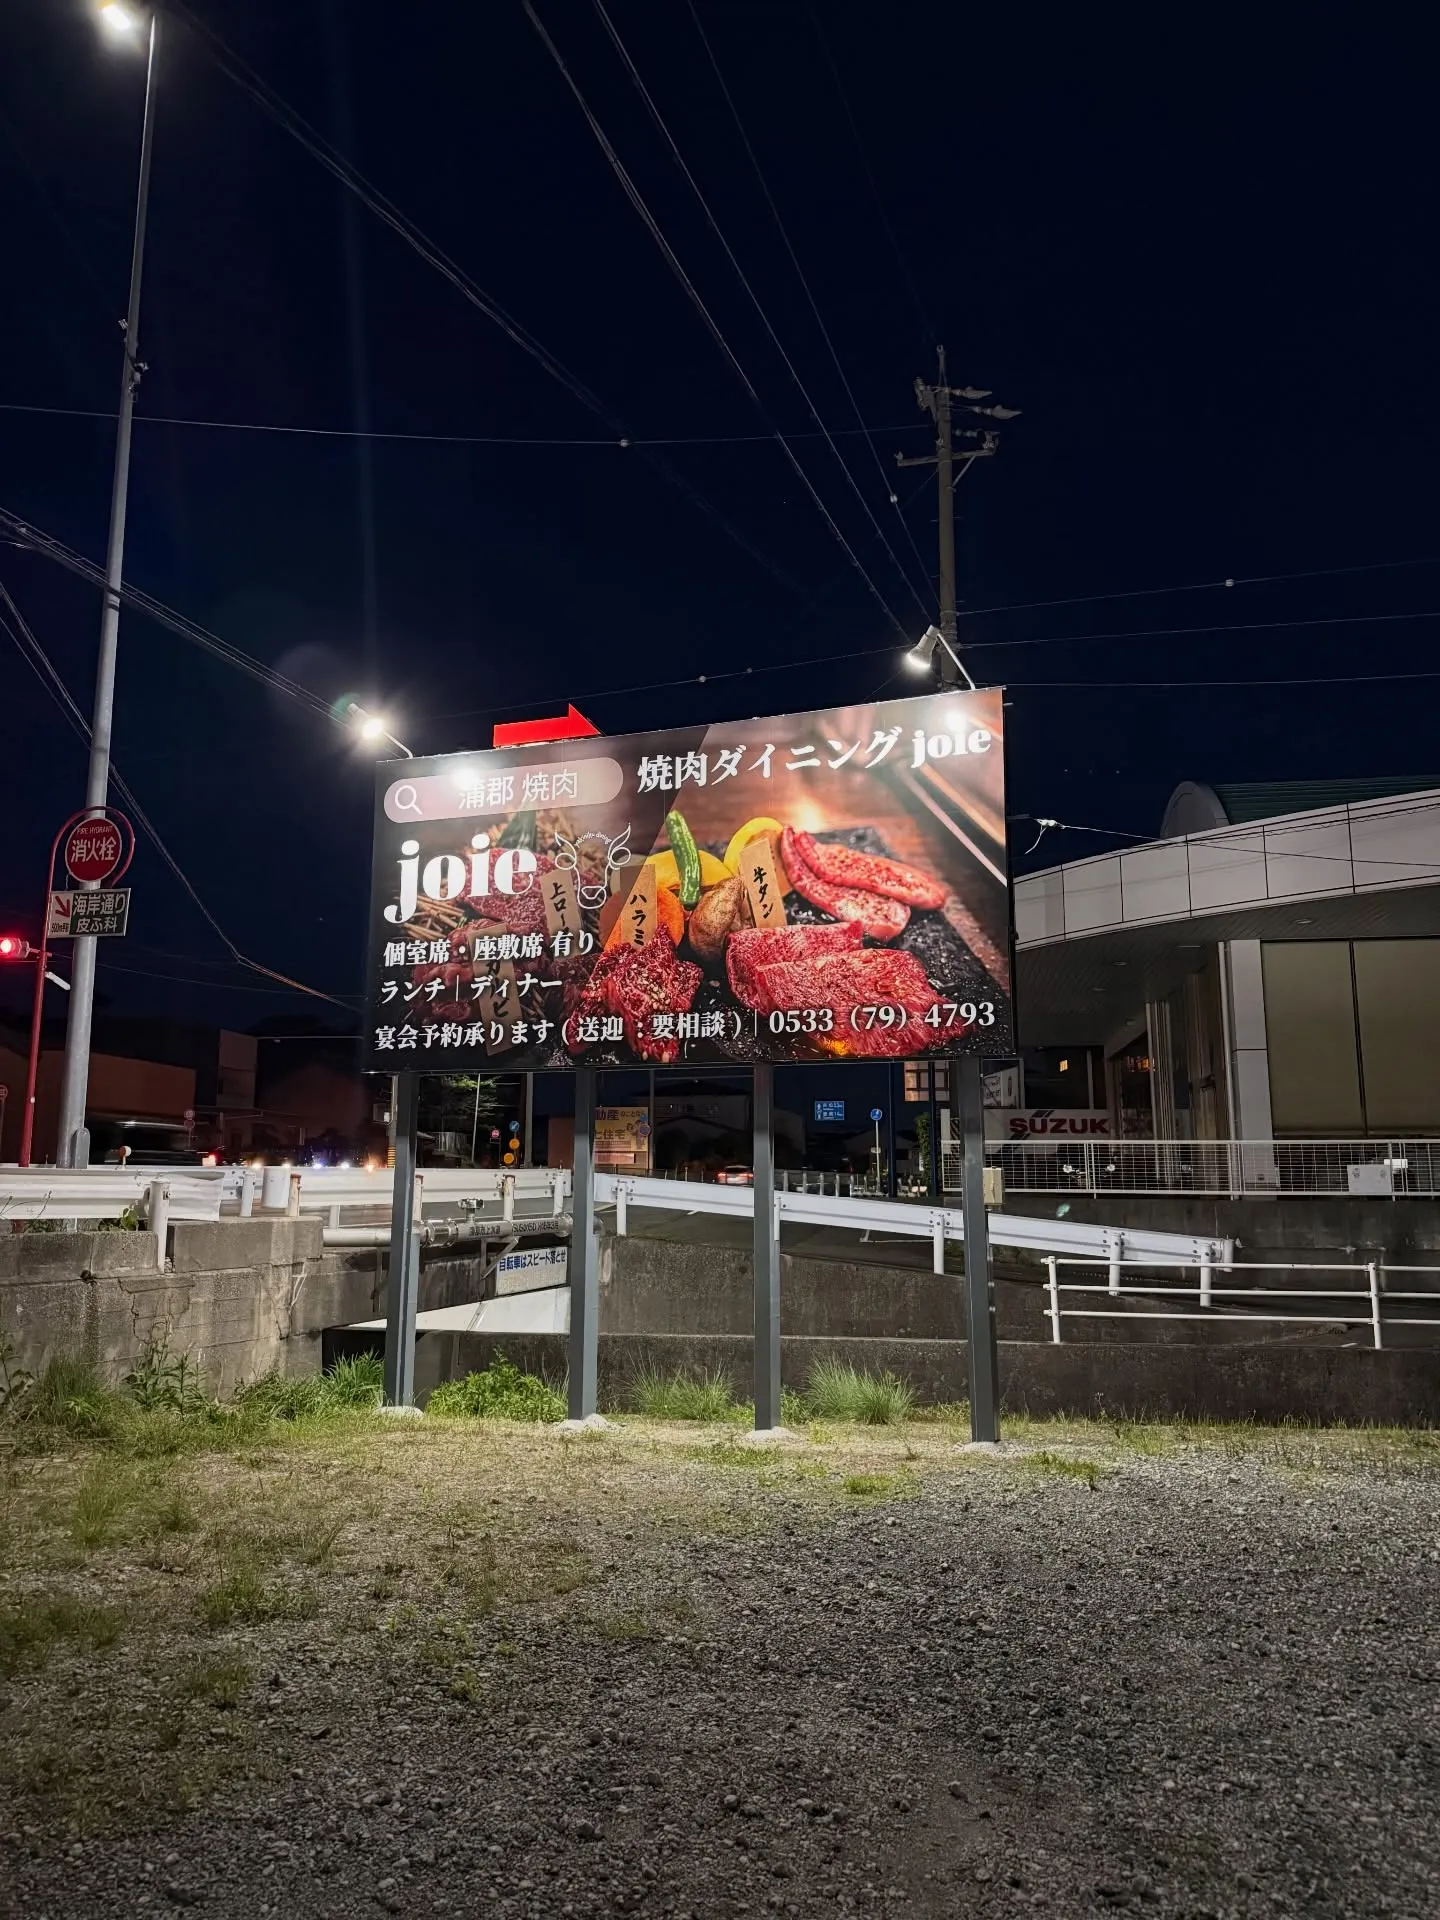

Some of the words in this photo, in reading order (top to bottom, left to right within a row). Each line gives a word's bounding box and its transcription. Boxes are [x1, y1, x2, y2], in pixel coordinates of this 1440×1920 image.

[636, 726, 903, 794] 焼肉ダイニング
[910, 727, 992, 768] joie
[521, 769, 578, 808] 焼肉
[71, 836, 117, 863] 消火栓
[384, 833, 537, 923] joie
[752, 866, 774, 919] 牛タン
[73, 893, 126, 916] 海岸通り
[550, 882, 570, 934] 上ロー
[630, 893, 648, 946] ハラミ
[76, 916, 118, 933] 皮ふ科
[384, 933, 543, 967] 個室席・座敷席
[550, 930, 594, 957] 有り
[380, 977, 446, 1004] ランチ
[470, 973, 563, 1000] ディナー
[769, 1008, 834, 1033] 0533
[850, 1004, 907, 1032] (79)
[924, 1001, 995, 1028] 4793
[1009, 1117, 1110, 1134] SUZUK
[499, 1250, 566, 1272] 自転車はスピード落とせ
